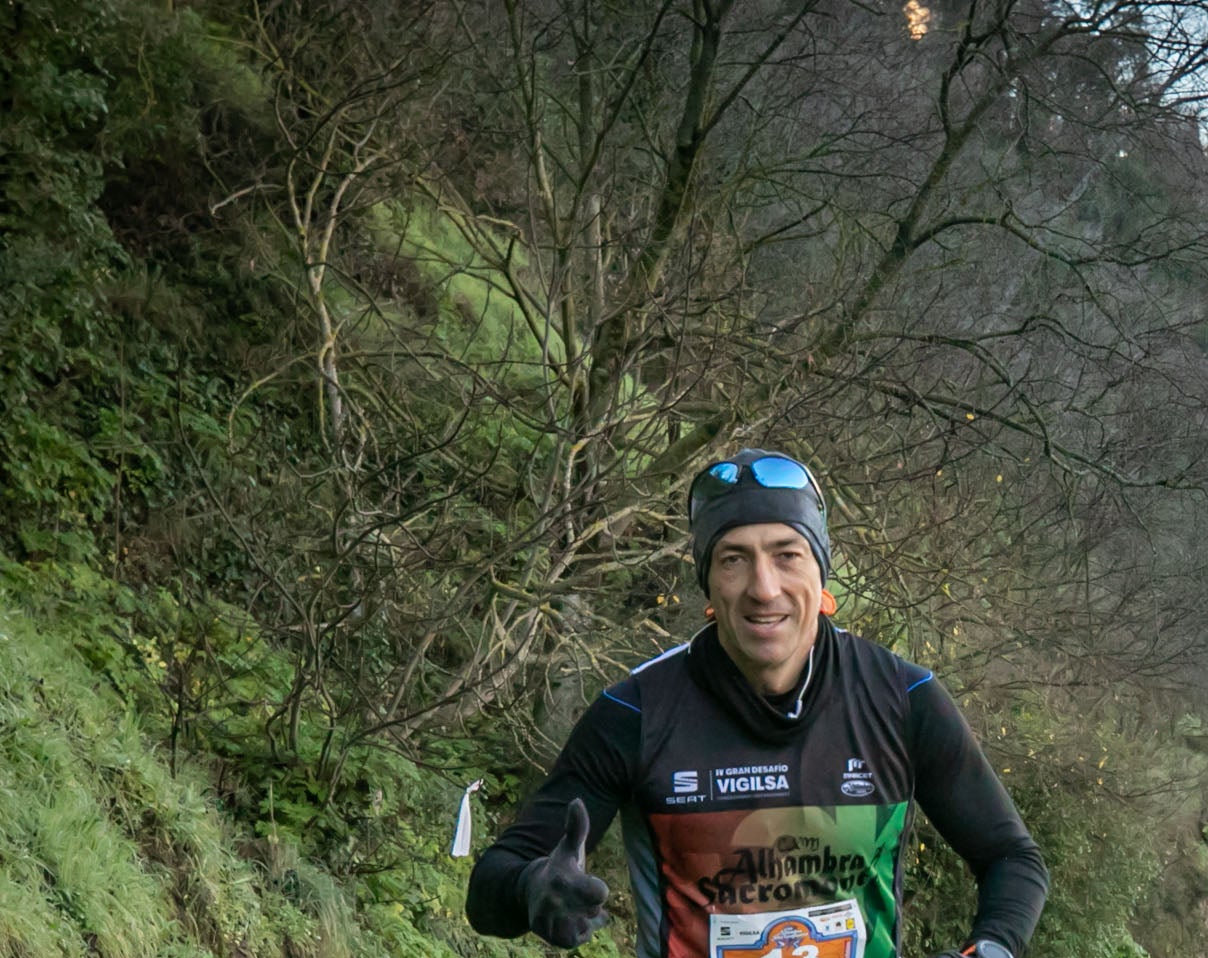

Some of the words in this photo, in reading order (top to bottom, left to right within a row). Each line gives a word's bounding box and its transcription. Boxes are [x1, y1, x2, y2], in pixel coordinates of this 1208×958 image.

[725, 766, 751, 776] GRAN
[716, 774, 790, 793] VIGILSA
[665, 794, 707, 805] SEAT
[713, 844, 866, 883] Alhambra
[697, 866, 870, 904] Sacroe
